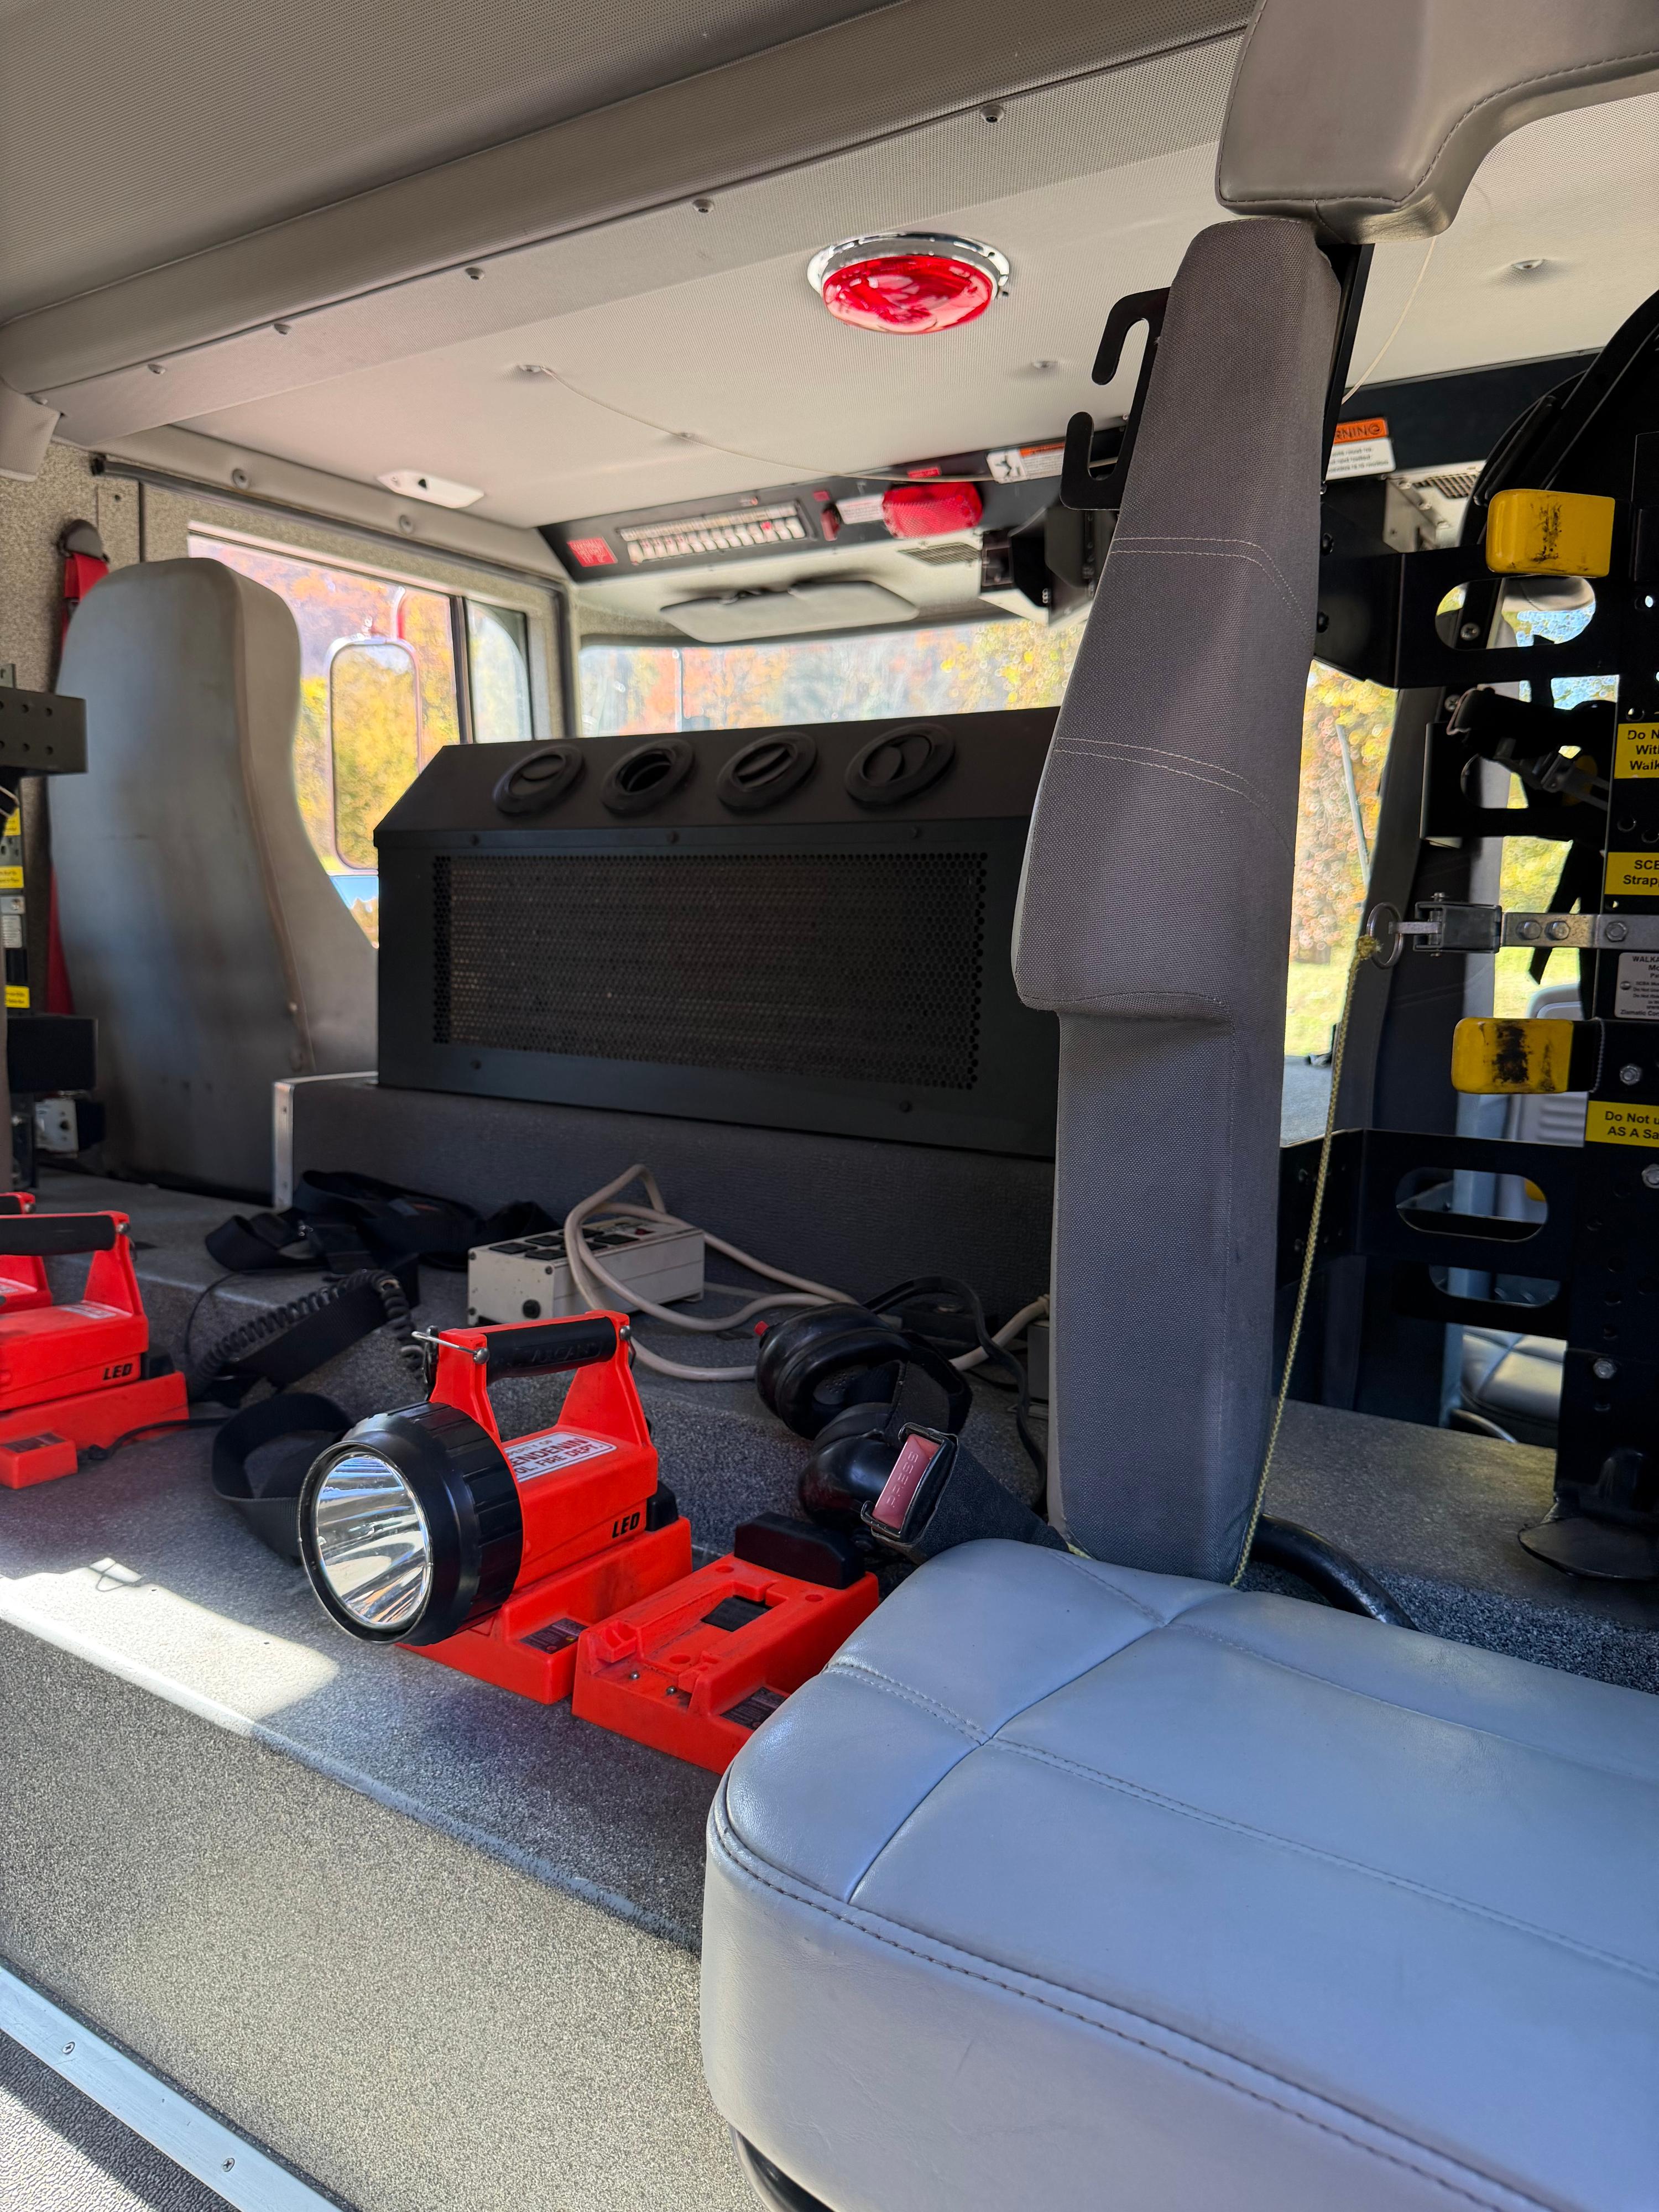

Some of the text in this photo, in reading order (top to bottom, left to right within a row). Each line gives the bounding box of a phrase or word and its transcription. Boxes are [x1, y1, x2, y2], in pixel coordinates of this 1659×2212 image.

[1628, 730, 1646, 740] Do
[1636, 745, 1659, 755] Wit
[1623, 874, 1659, 888] Strap
[1605, 1111, 1623, 1121] Do
[1627, 1113, 1649, 1124] Not
[1608, 1126, 1626, 1136] AS
[1630, 1128, 1639, 1138] A
[103, 1363, 133, 1380] LED
[510, 1438, 589, 1467] ENDENIN
[514, 1444, 603, 1475] OL. FIRE DEPT.
[886, 1451, 919, 1509] PRESS
[612, 1511, 640, 1538] LED
